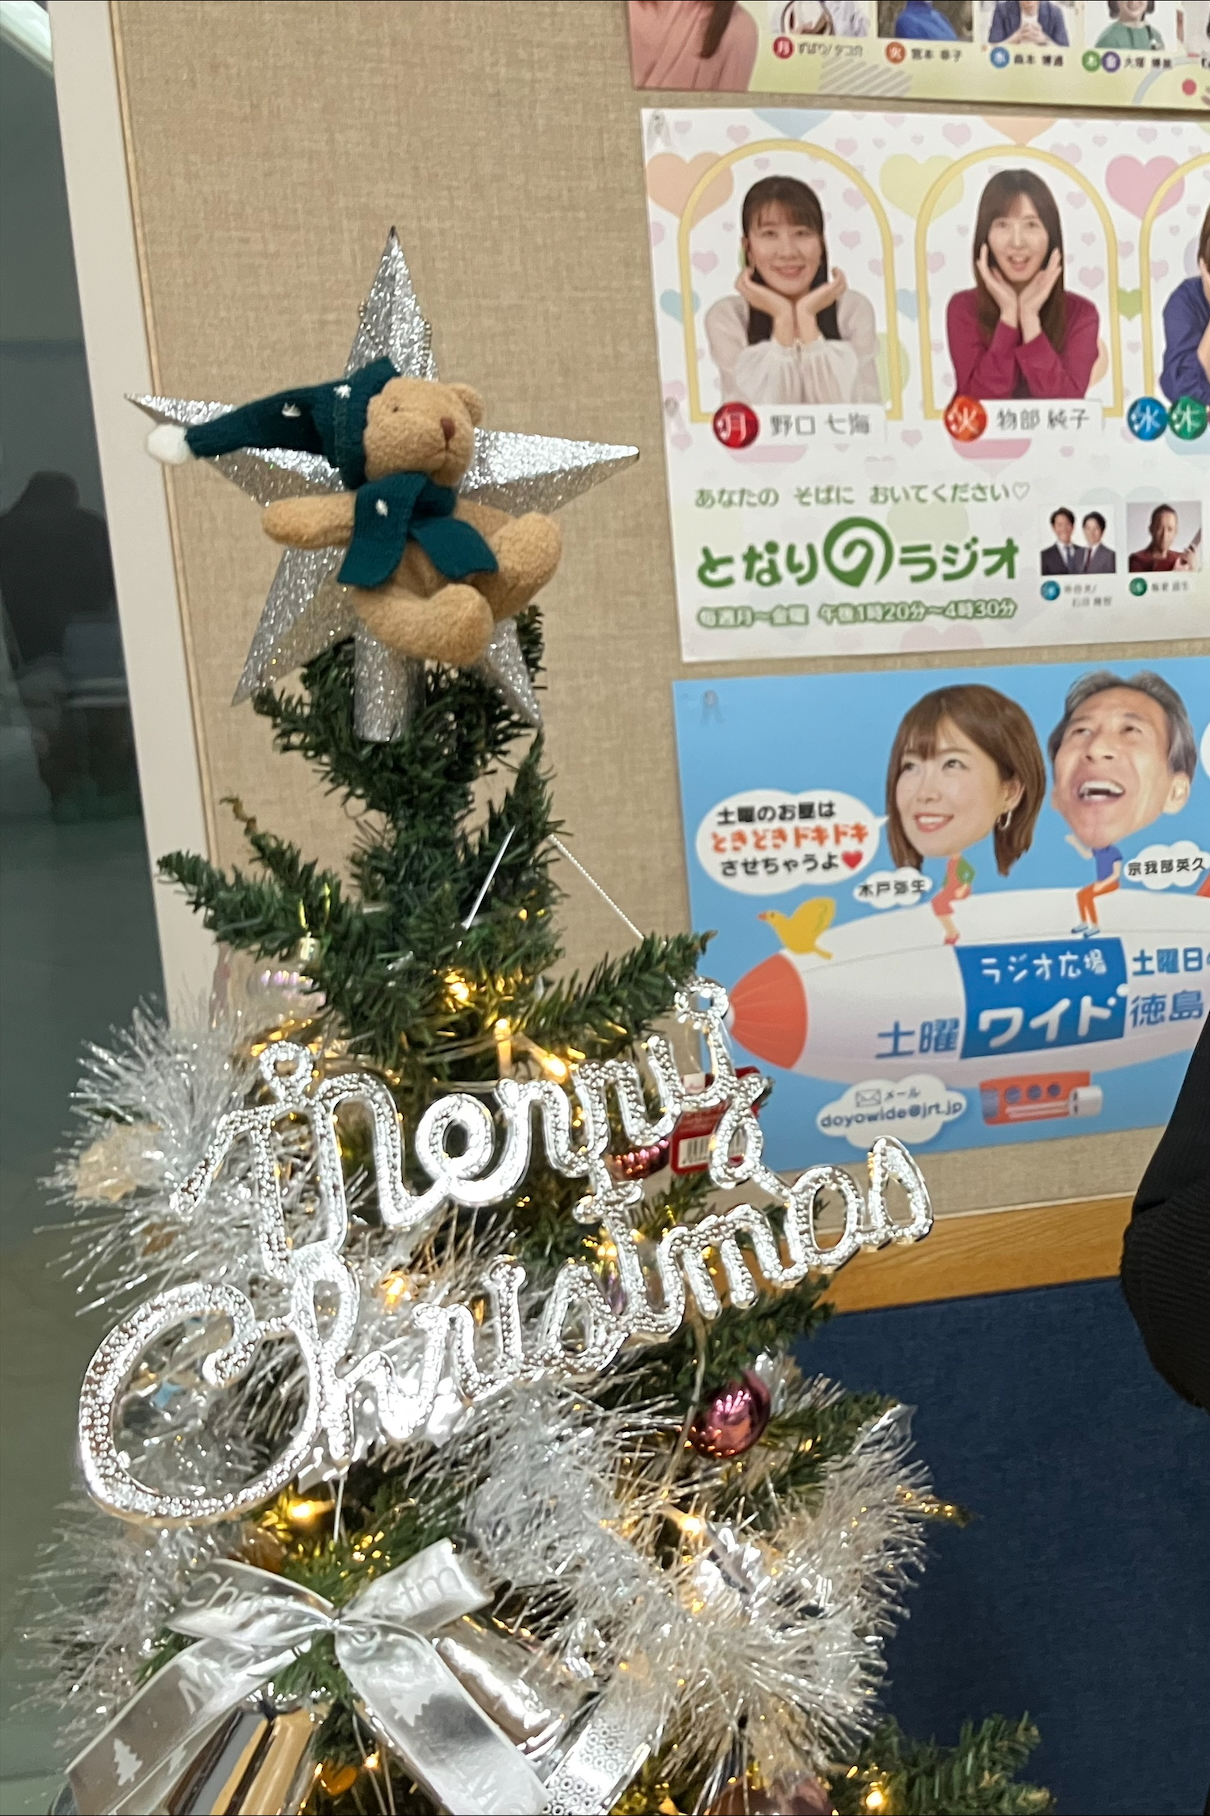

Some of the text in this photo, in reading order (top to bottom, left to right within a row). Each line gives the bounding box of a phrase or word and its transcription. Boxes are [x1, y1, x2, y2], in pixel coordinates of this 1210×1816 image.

[694, 487, 780, 509] あなたの
[792, 484, 855, 507] そばに
[697, 517, 1020, 589] となりのラジオ
[717, 801, 836, 826] 土曜のお昼は
[721, 852, 840, 877] させちゃうよ
[858, 880, 926, 898] 木戸弥生
[981, 949, 1108, 984] ラジオ広場
